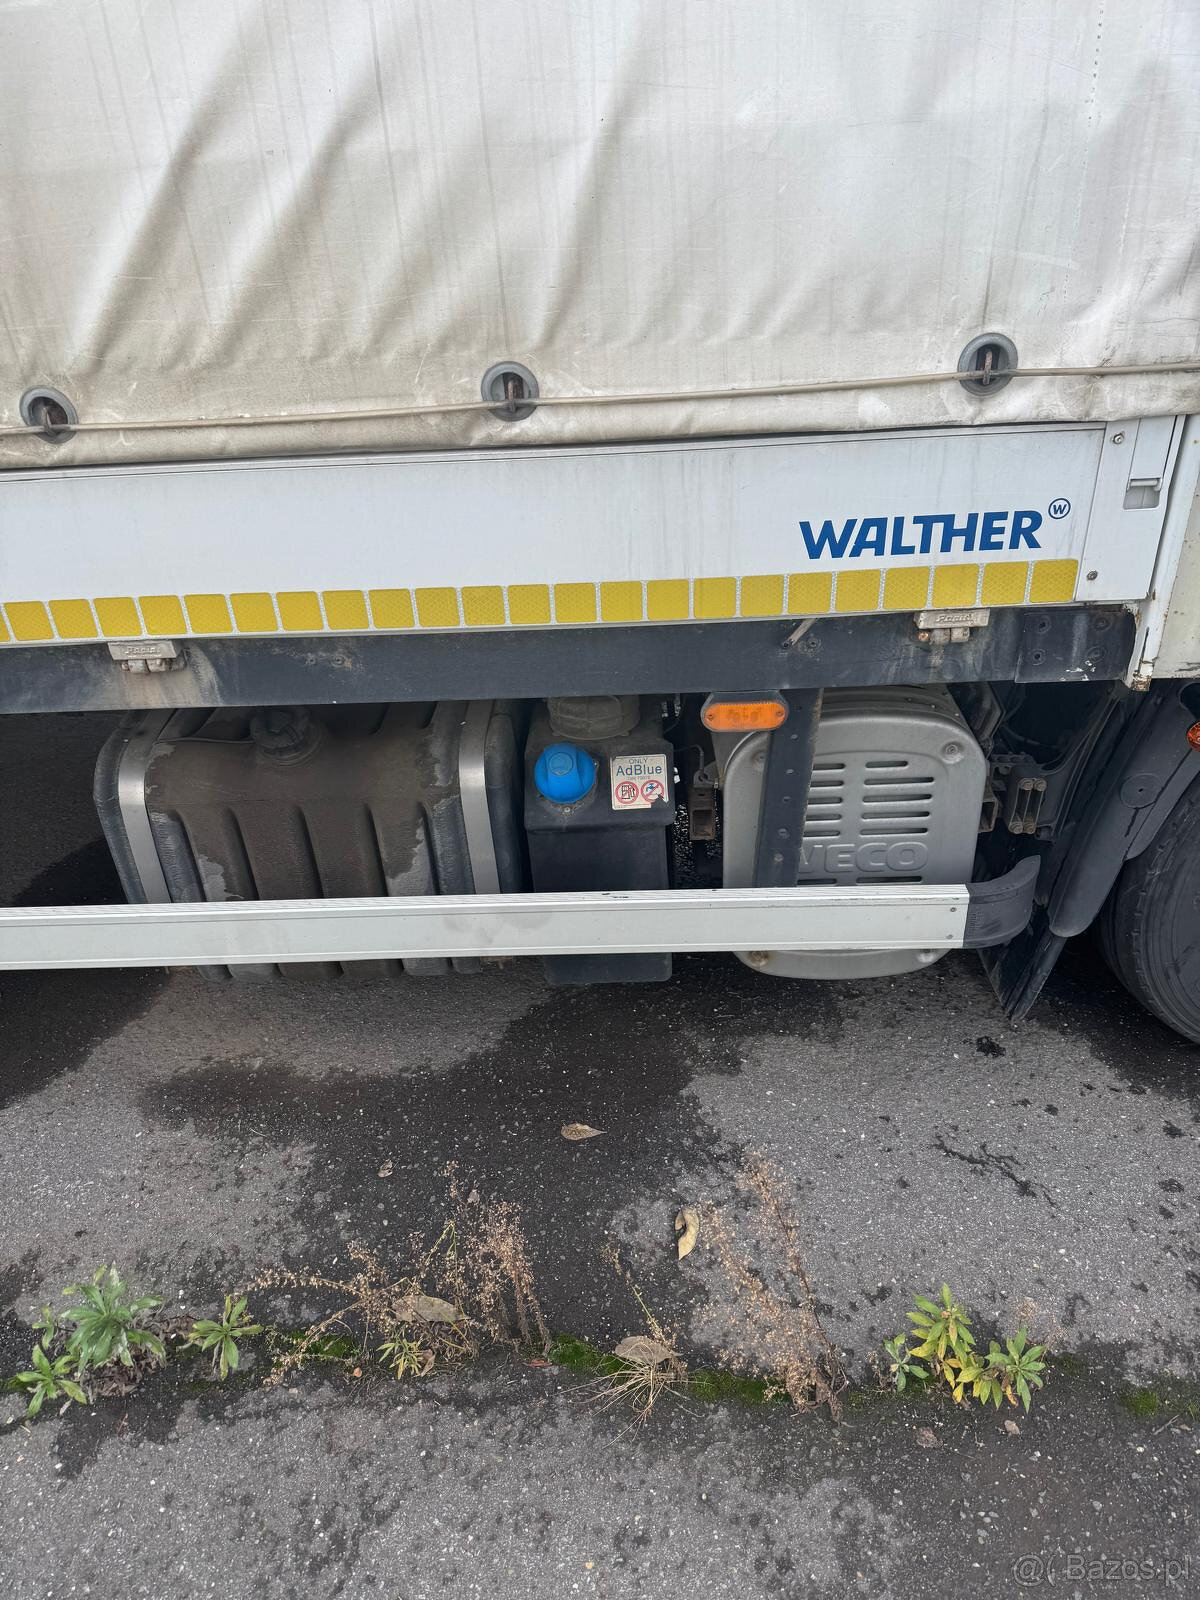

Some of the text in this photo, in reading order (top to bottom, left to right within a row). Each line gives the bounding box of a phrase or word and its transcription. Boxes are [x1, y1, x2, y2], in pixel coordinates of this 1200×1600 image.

[799, 510, 1043, 560] WALTHER
[616, 764, 662, 776] AdBlue
[629, 757, 648, 765] ONLY
[798, 841, 928, 873] VECO
